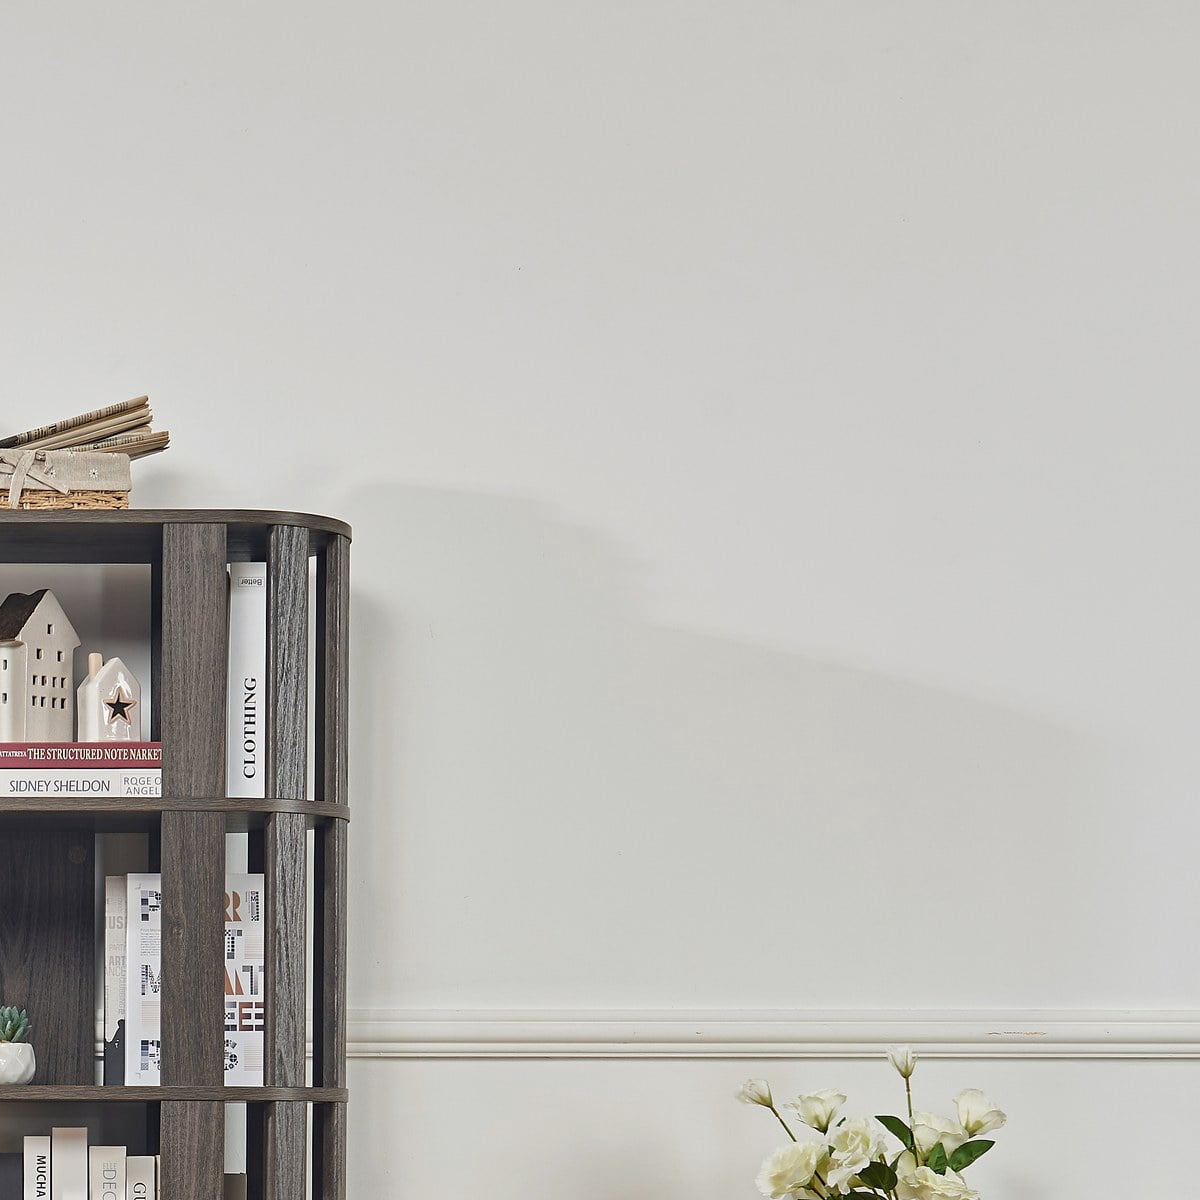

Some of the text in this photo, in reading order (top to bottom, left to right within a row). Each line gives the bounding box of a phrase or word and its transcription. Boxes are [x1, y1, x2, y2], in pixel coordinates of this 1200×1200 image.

[243, 677, 256, 779] CLOTHING
[27, 748, 46, 760] THE
[46, 748, 103, 760] STRUCTURED
[104, 748, 129, 760] NOTE
[9, 780, 110, 793] SIDNEY SHELDON
[126, 787, 160, 795] ANGEL
[36, 1155, 46, 1198] MUCHA
